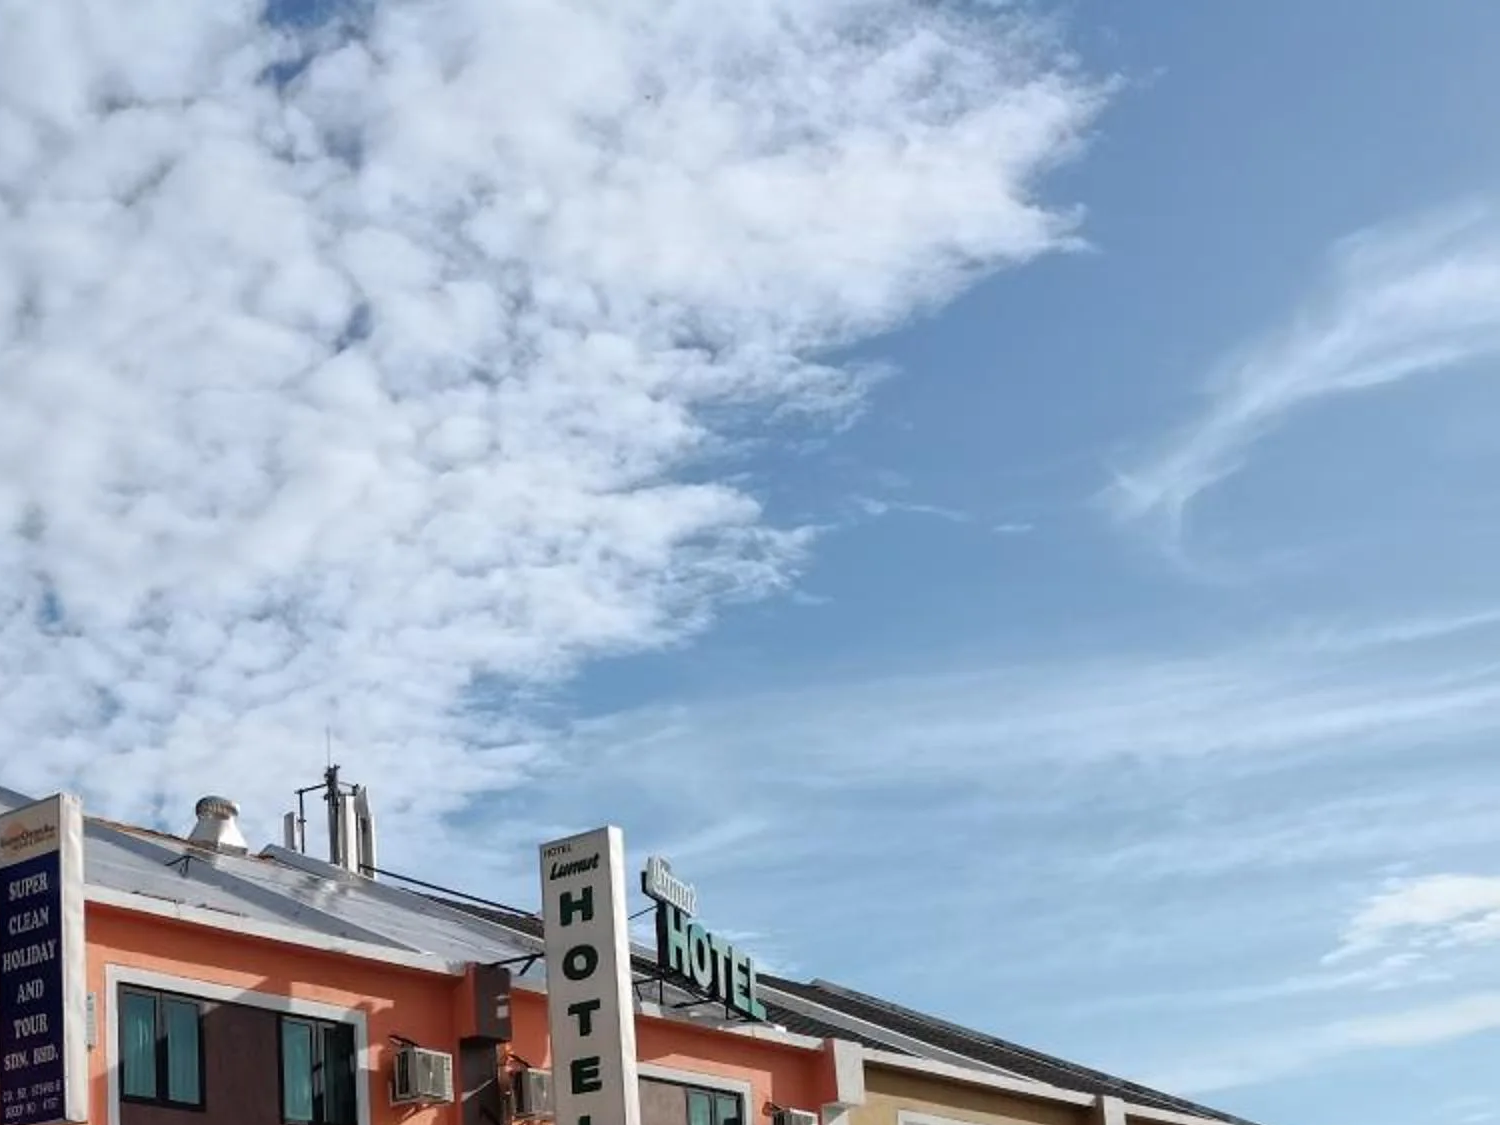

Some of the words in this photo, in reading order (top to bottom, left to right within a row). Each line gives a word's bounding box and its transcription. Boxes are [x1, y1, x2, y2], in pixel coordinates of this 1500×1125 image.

[549, 852, 600, 880] Lumut
[8, 871, 49, 902] SUPER
[7, 905, 50, 937] CLEAN
[1, 938, 58, 973] HOLIDAY
[665, 903, 768, 1021] HOTEL
[16, 978, 45, 1005] AND
[12, 1012, 49, 1040] TOUR
